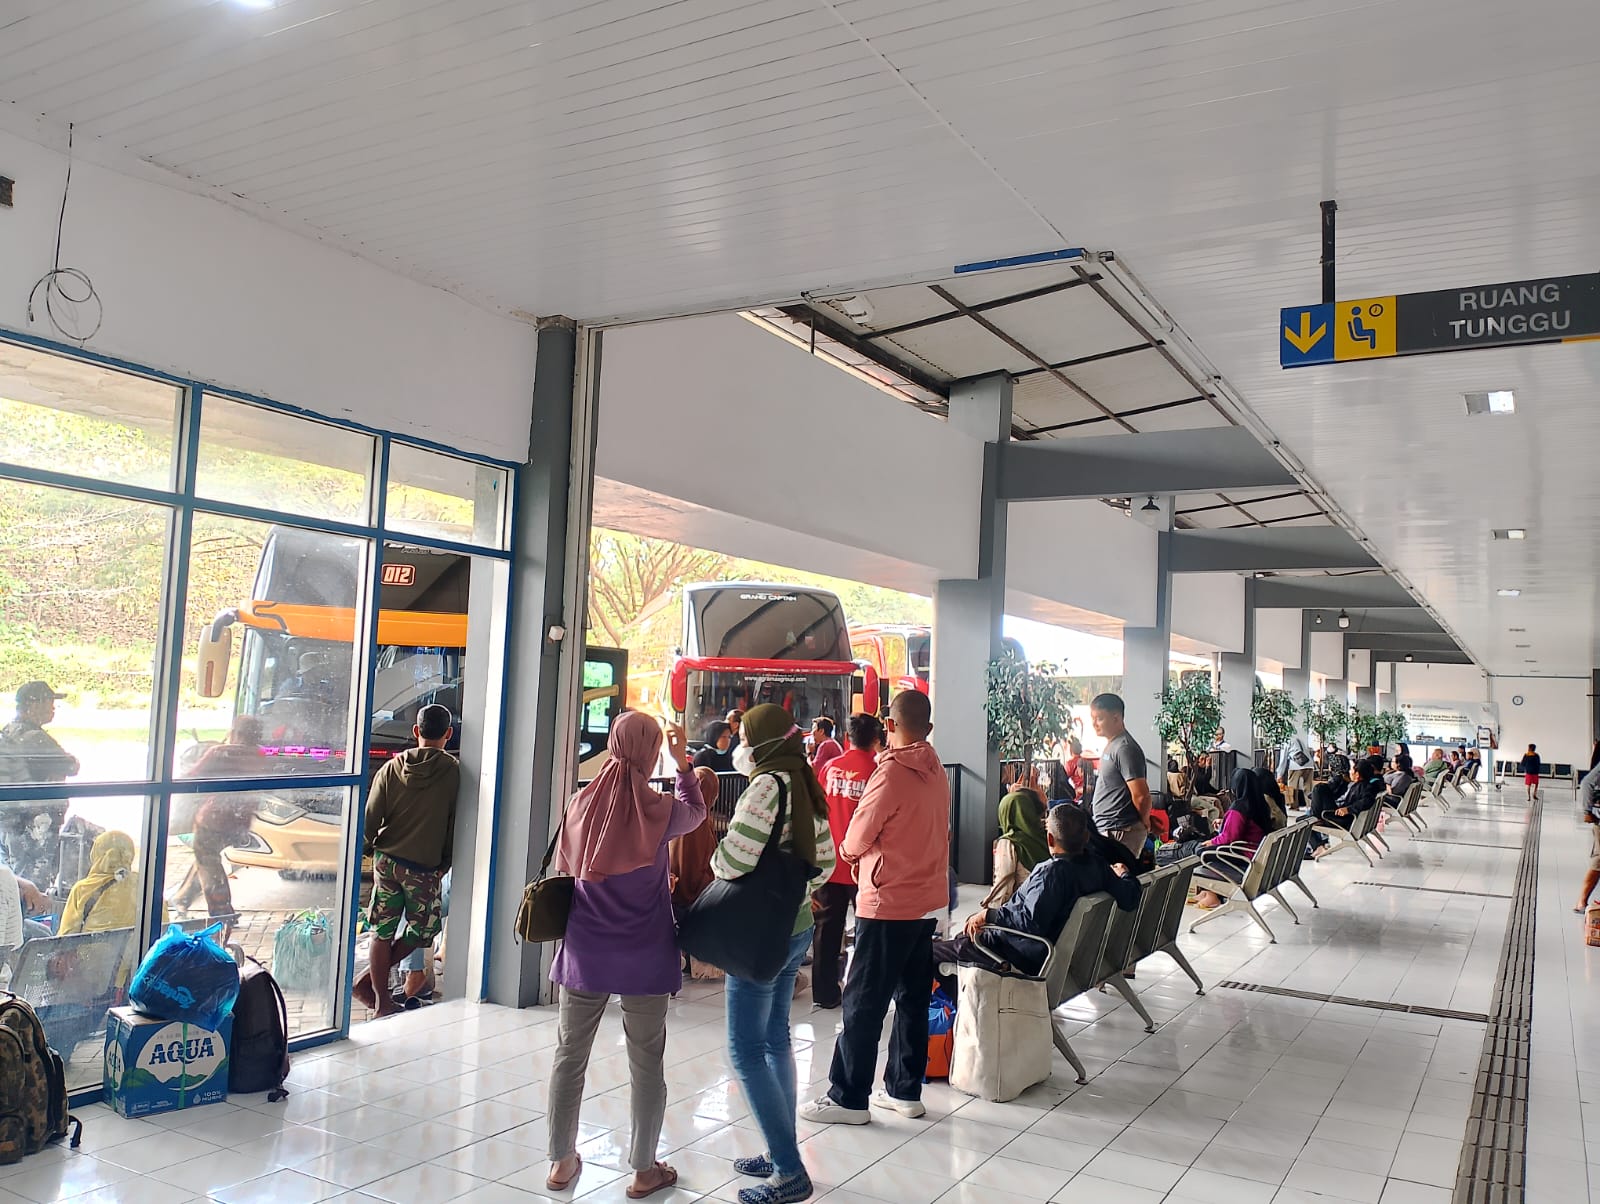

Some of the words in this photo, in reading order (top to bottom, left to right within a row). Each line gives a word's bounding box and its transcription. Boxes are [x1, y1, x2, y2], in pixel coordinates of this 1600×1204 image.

[1459, 283, 1560, 312] RUANG
[1449, 310, 1571, 339] TUNGGU
[383, 566, 411, 583] 012
[149, 1037, 215, 1065] AQUA
